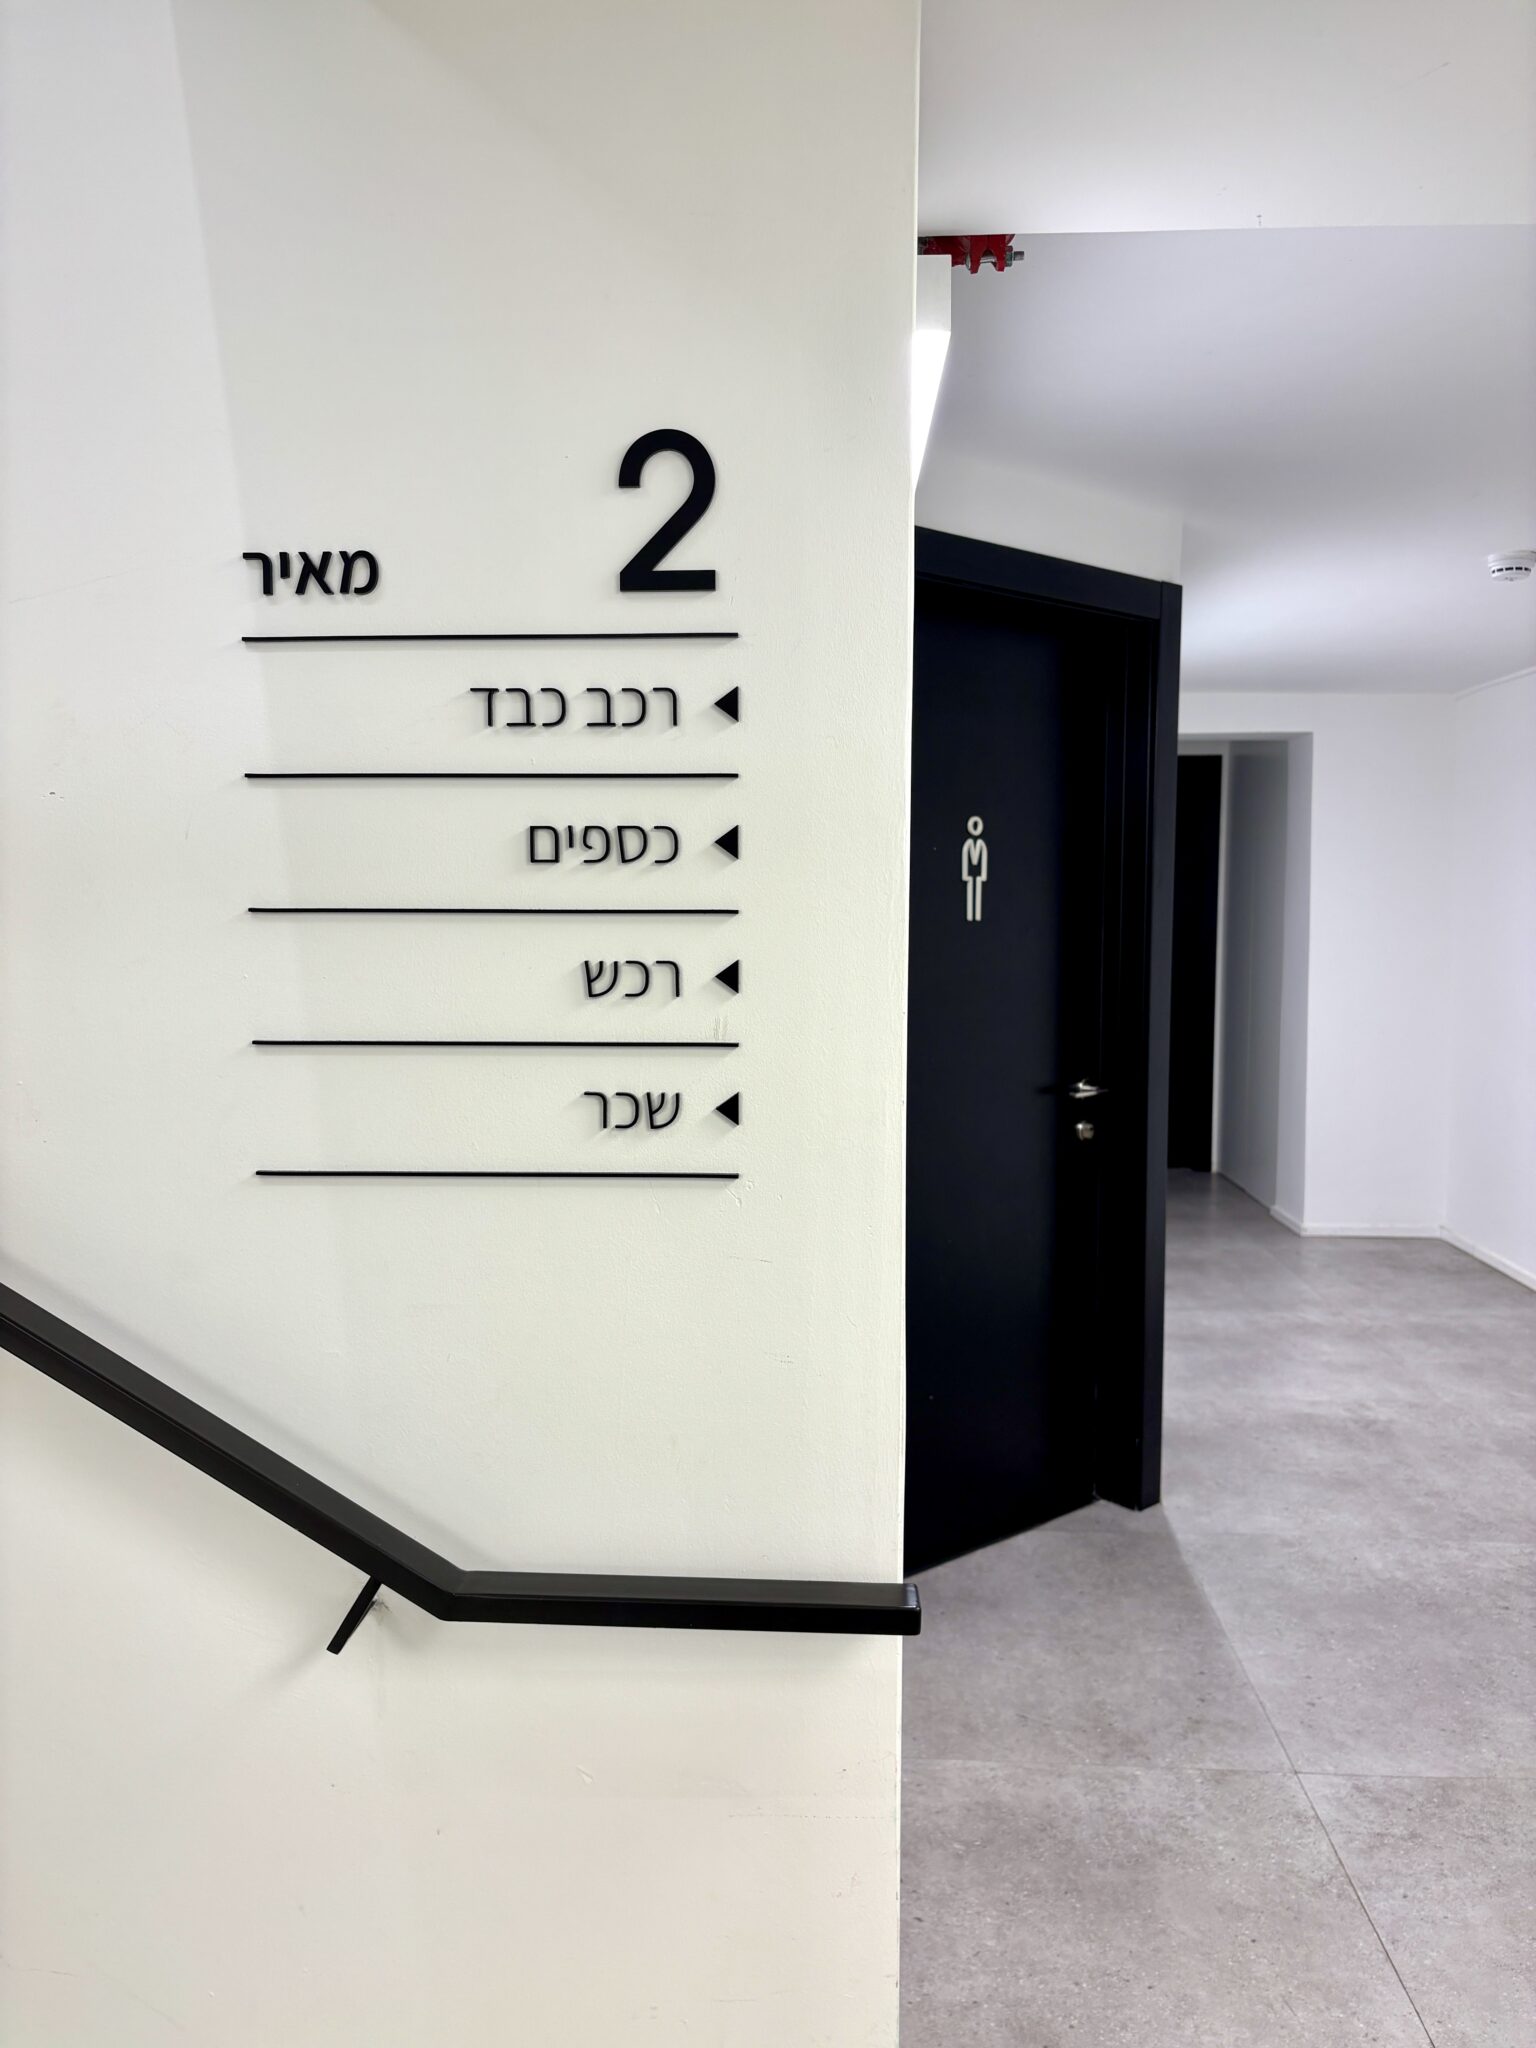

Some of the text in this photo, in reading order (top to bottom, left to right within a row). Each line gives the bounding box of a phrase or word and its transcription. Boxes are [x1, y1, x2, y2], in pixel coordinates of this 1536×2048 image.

[617, 428, 717, 593] 2
[242, 549, 380, 597] מאיר
[469, 687, 679, 728] רכב כבד
[529, 825, 680, 865] כספים
[584, 960, 681, 999] רכש
[583, 1091, 681, 1130] שכר
